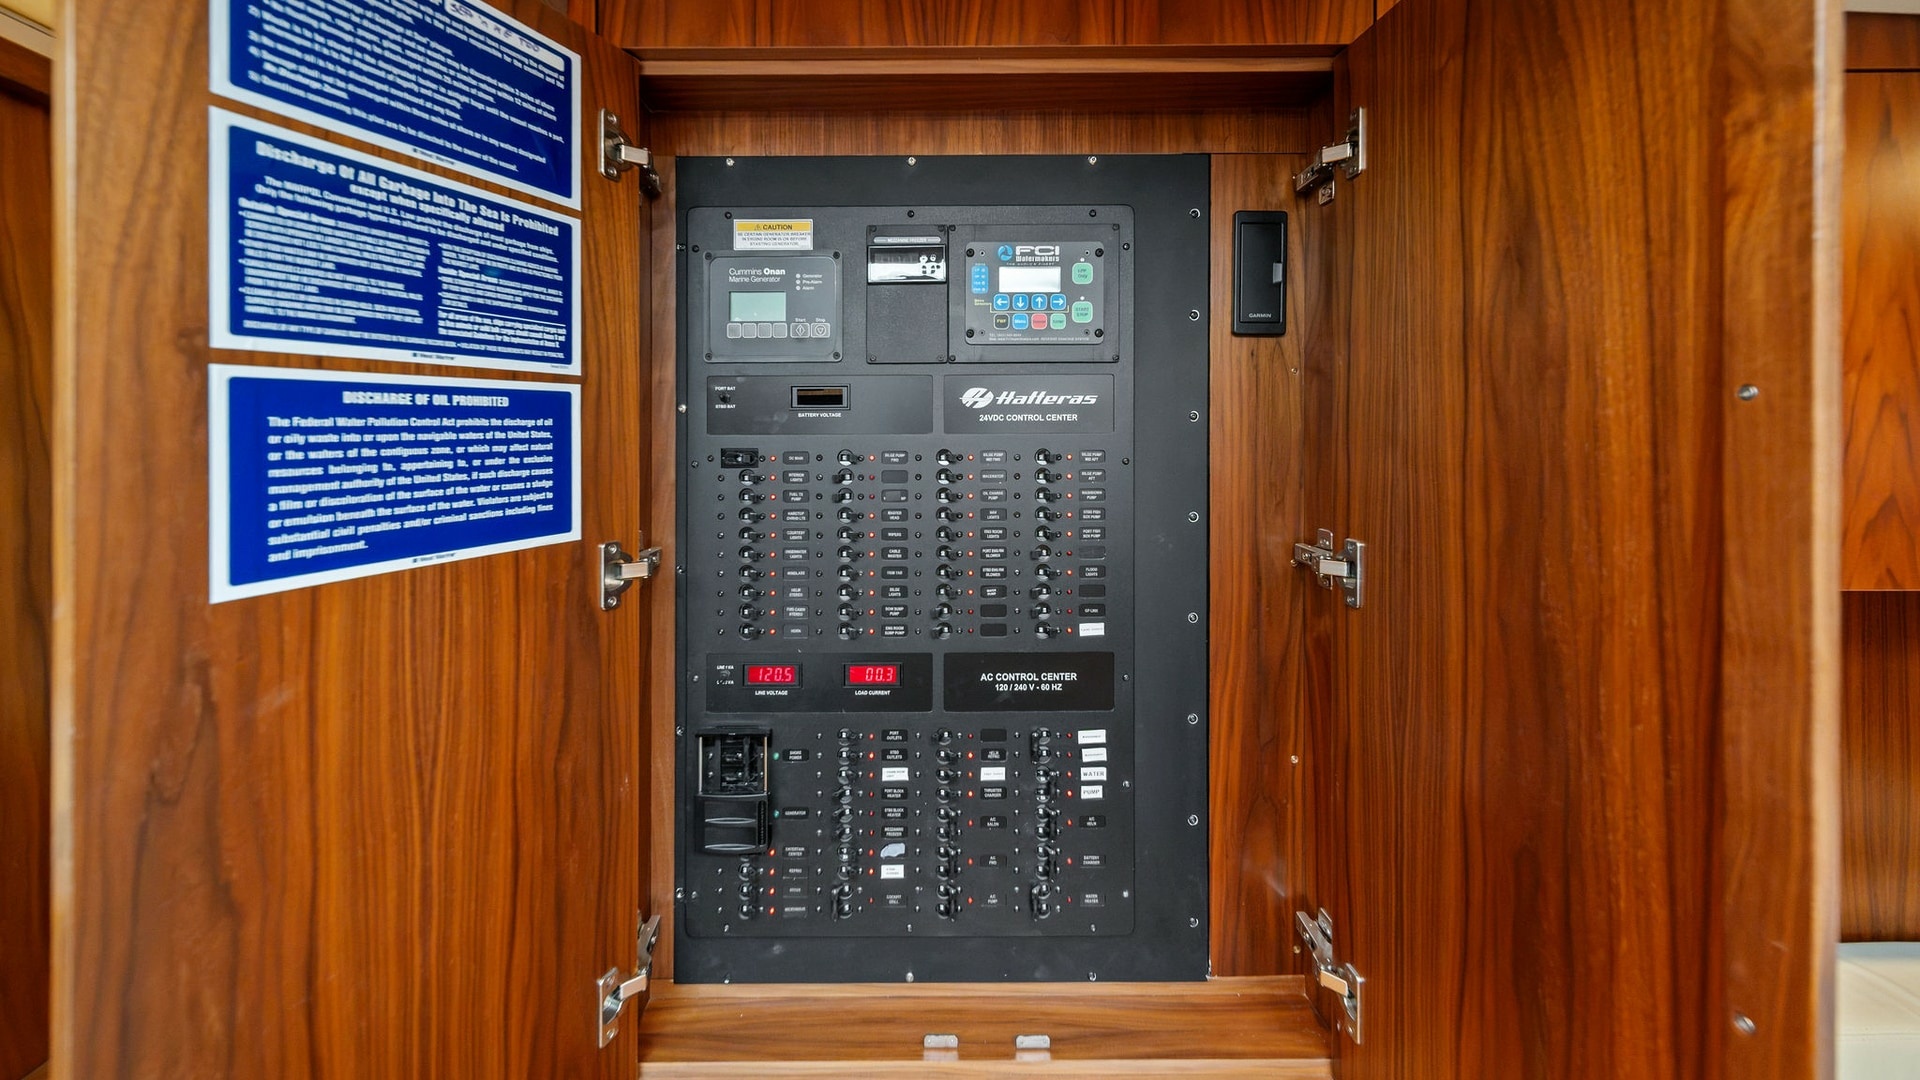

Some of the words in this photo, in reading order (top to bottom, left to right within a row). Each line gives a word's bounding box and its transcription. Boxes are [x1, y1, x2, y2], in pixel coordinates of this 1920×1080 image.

[255, 140, 336, 178] Discharge
[338, 164, 355, 181] Of
[357, 169, 376, 187] All
[377, 175, 431, 203] Garbage
[432, 190, 456, 208] Into
[457, 198, 478, 214] The
[478, 204, 499, 220] Sea
[511, 213, 559, 236] Prohibited
[348, 182, 388, 203] except
[388, 192, 417, 209] when
[417, 200, 471, 224] specifically
[471, 214, 505, 232] allowed
[1015, 245, 1060, 256] FCI
[728, 267, 762, 276] Cummins
[763, 267, 786, 275] Onan
[342, 390, 413, 405] DISCHARGE
[414, 393, 430, 405] OF
[431, 393, 450, 405] OIL
[451, 394, 509, 407] PROHIBITED
[995, 390, 1099, 405] Hatteras
[267, 416, 291, 427] The
[291, 416, 334, 427] Federal
[334, 417, 366, 426] Water
[366, 417, 409, 426] Pollution
[409, 417, 441, 426] Control
[440, 417, 456, 426] Act
[455, 417, 490, 427] prohibits
[488, 418, 502, 426] the
[502, 418, 536, 427] discharge
[535, 418, 544, 426] of
[543, 418, 553, 426] oil
[979, 414, 1005, 422] 24VDC
[267, 435, 282, 444] or
[282, 433, 306, 445] oily
[306, 432, 340, 443] waste
[340, 432, 362, 442] into
[362, 434, 374, 442] or
[374, 433, 400, 442] upon
[399, 432, 416, 441] the
[416, 431, 457, 442] navigable
[457, 431, 484, 440] waters
[484, 431, 494, 439] of
[493, 431, 506, 439] the
[506, 430, 530, 439] United
[529, 430, 552, 439] States,
[267, 452, 282, 461] or
[284, 449, 305, 460] the
[306, 448, 344, 459] waters
[346, 448, 359, 458] of
[360, 447, 378, 457] the
[379, 446, 429, 458] contiguous
[430, 446, 453, 456] zone,
[455, 446, 465, 454] or
[466, 444, 490, 453] which
[491, 445, 508, 453] may
[508, 443, 529, 452] affect
[529, 442, 553, 451] natural
[267, 466, 324, 478] resources
[327, 462, 378, 476] belonging
[381, 461, 396, 472] to,
[399, 459, 454, 471] appertaining
[456, 458, 469, 468] to,
[483, 456, 506, 466] under
[508, 456, 520, 464] the
[522, 454, 553, 464] exclusive
[267, 480, 340, 496] management
[340, 477, 385, 490] authority
[385, 476, 397, 486] of
[395, 475, 412, 485] the
[412, 473, 442, 484] United
[441, 472, 470, 483] States,
[470, 471, 478, 480] if
[477, 470, 497, 479] such
[496, 468, 530, 479] discharge
[530, 468, 553, 476] causes
[758, 667, 793, 682] 120.5
[864, 667, 893, 682] 00.3
[980, 672, 994, 681] AC
[995, 672, 1039, 681] CONTROL
[1040, 672, 1078, 681] CENTER
[995, 683, 1008, 691] 120
[1013, 683, 1028, 691] 240
[1028, 683, 1035, 691] V
[1040, 683, 1050, 691] 60
[1051, 683, 1063, 691] HZ
